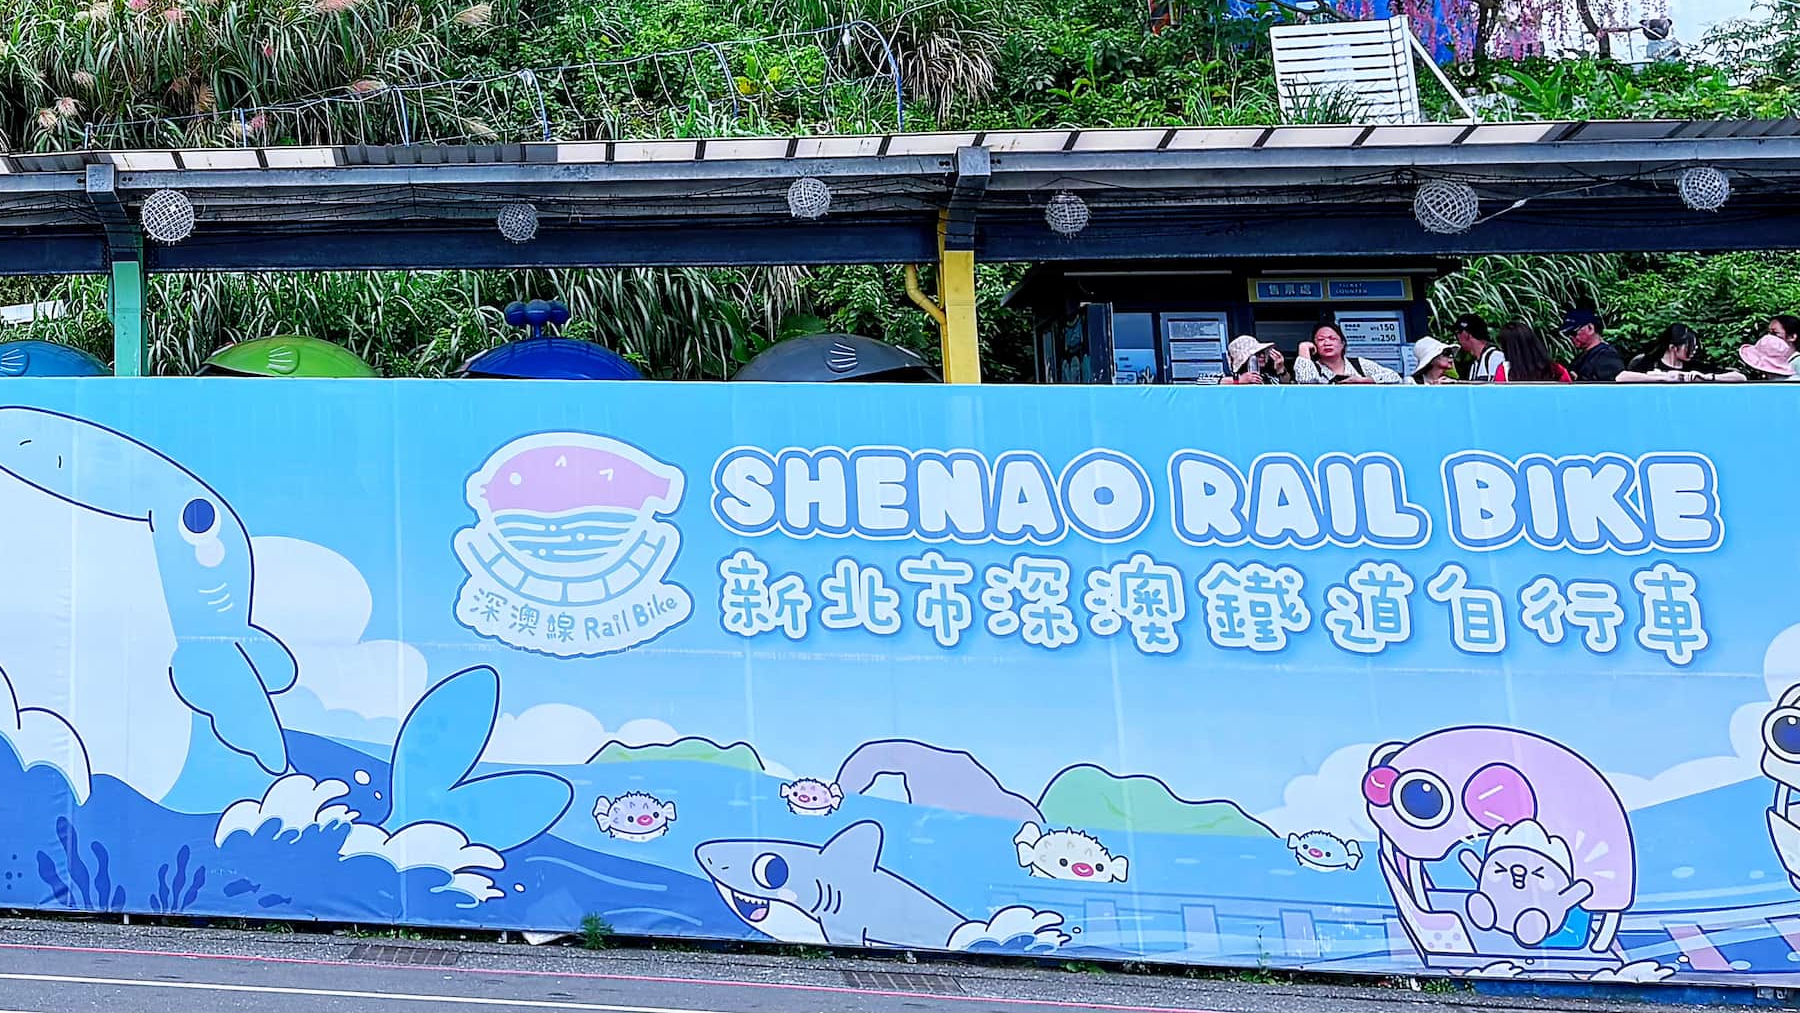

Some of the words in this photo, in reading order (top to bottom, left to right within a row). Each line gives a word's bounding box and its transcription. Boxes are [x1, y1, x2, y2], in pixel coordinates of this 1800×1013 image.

[716, 451, 1150, 541] SHENAO
[1172, 453, 1427, 546] RAIL
[1445, 454, 1720, 550] BIKE
[468, 588, 576, 643] 深澳線
[584, 609, 630, 641] Rail
[633, 594, 678, 628] Bike
[723, 555, 1704, 663] 新北市深澳鐵道自行車
